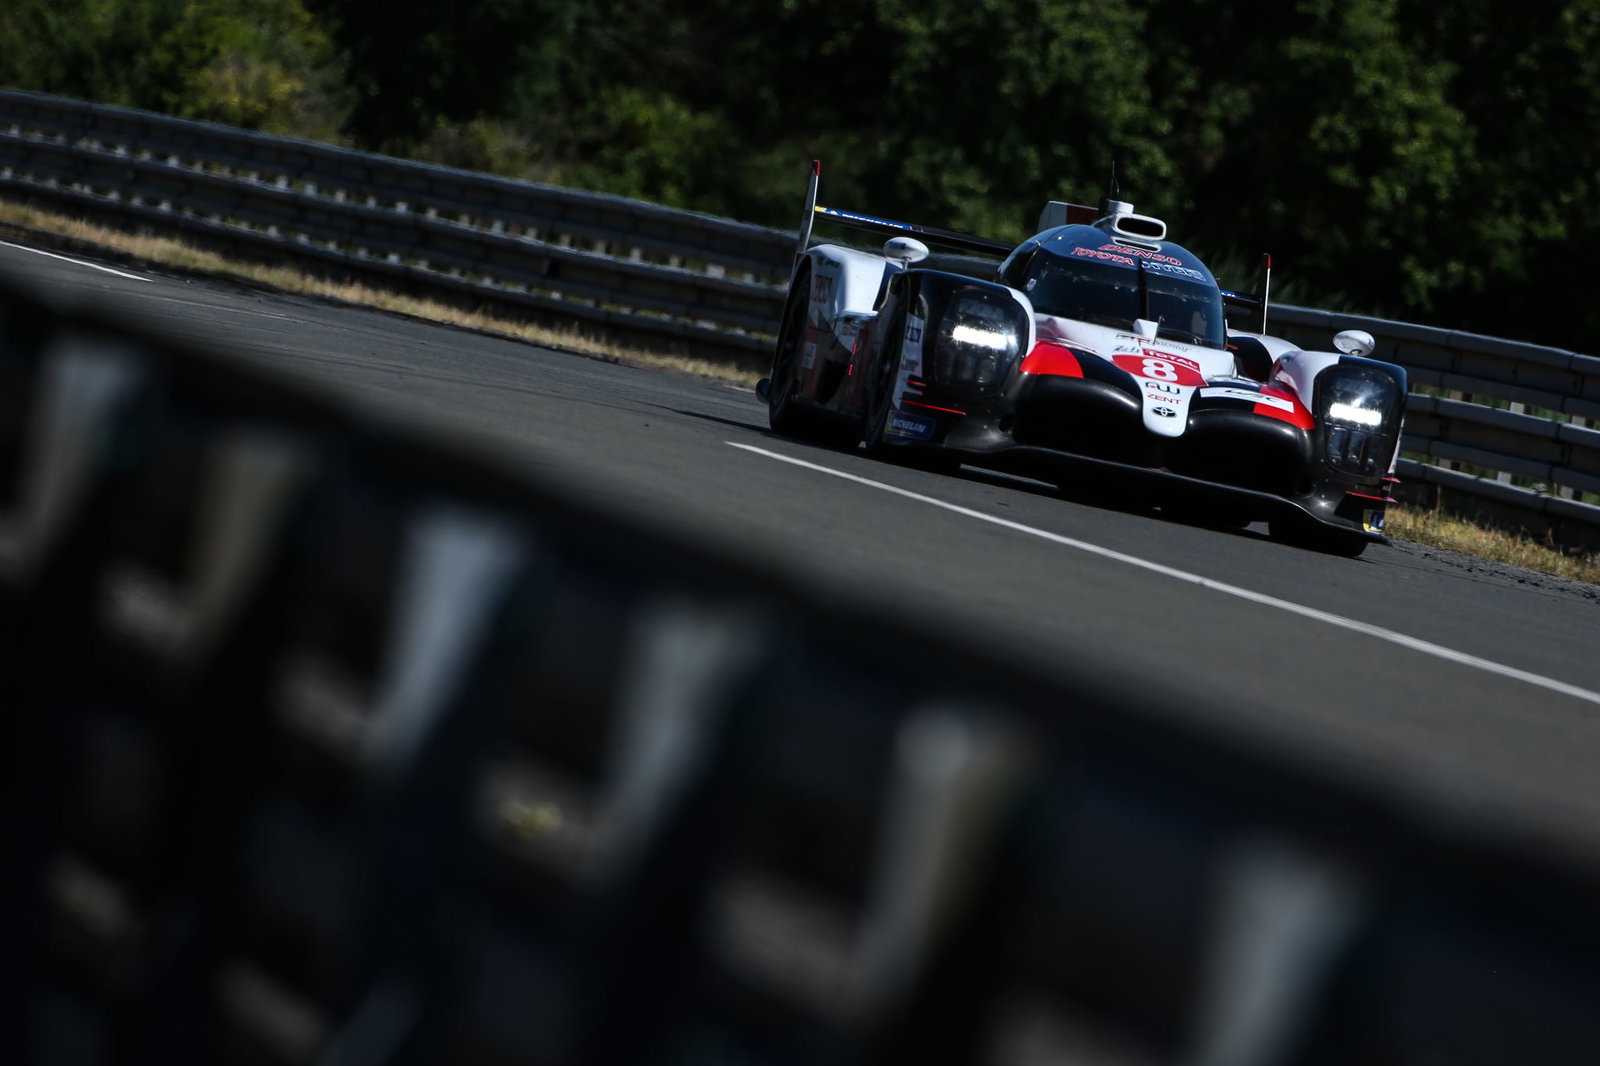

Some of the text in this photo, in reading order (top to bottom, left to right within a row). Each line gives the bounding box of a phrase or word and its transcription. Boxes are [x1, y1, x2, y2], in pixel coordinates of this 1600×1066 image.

[1071, 246, 1135, 266] TOYOTA
[1098, 243, 1182, 266] DENSO
[1147, 349, 1197, 368] TOTAL
[1141, 358, 1179, 382] 8
[1146, 392, 1182, 405] ZENT
